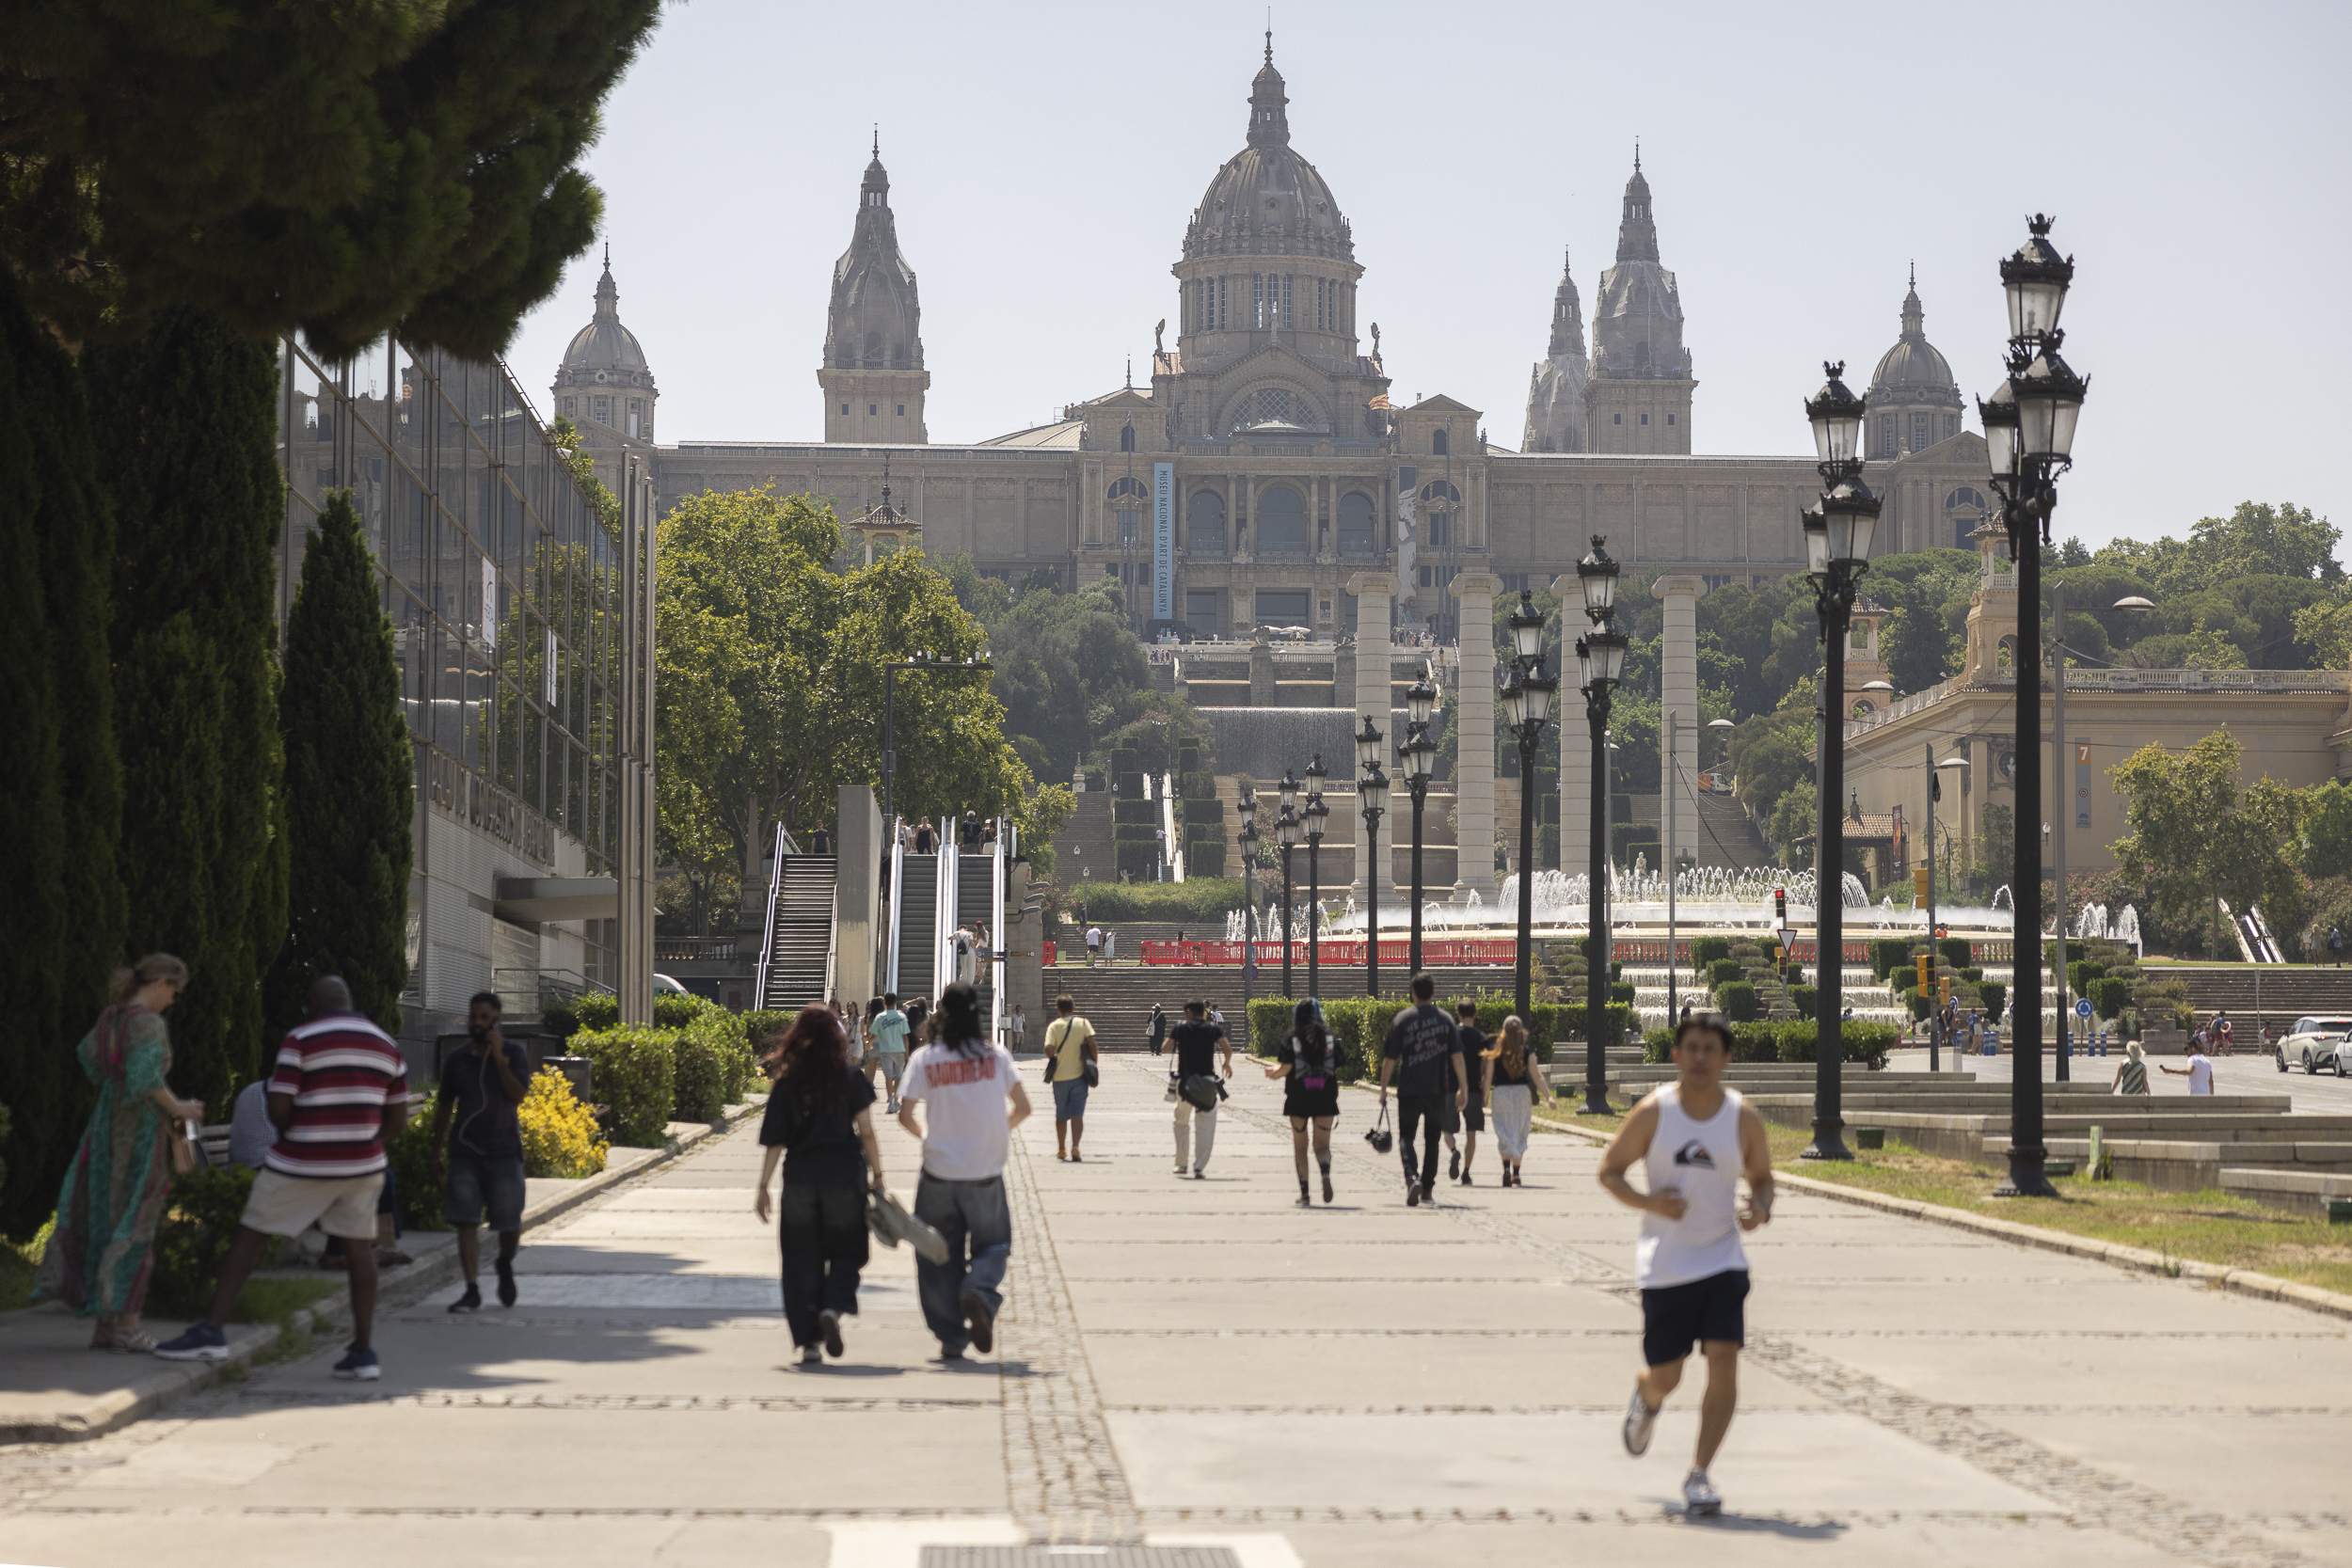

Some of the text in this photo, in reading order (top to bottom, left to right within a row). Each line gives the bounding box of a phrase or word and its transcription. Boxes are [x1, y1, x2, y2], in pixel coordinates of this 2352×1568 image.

[1159, 470, 1168, 612] MUSEU NACIONAL D'ART DE CATALUNYA
[2080, 746, 2089, 760] 7
